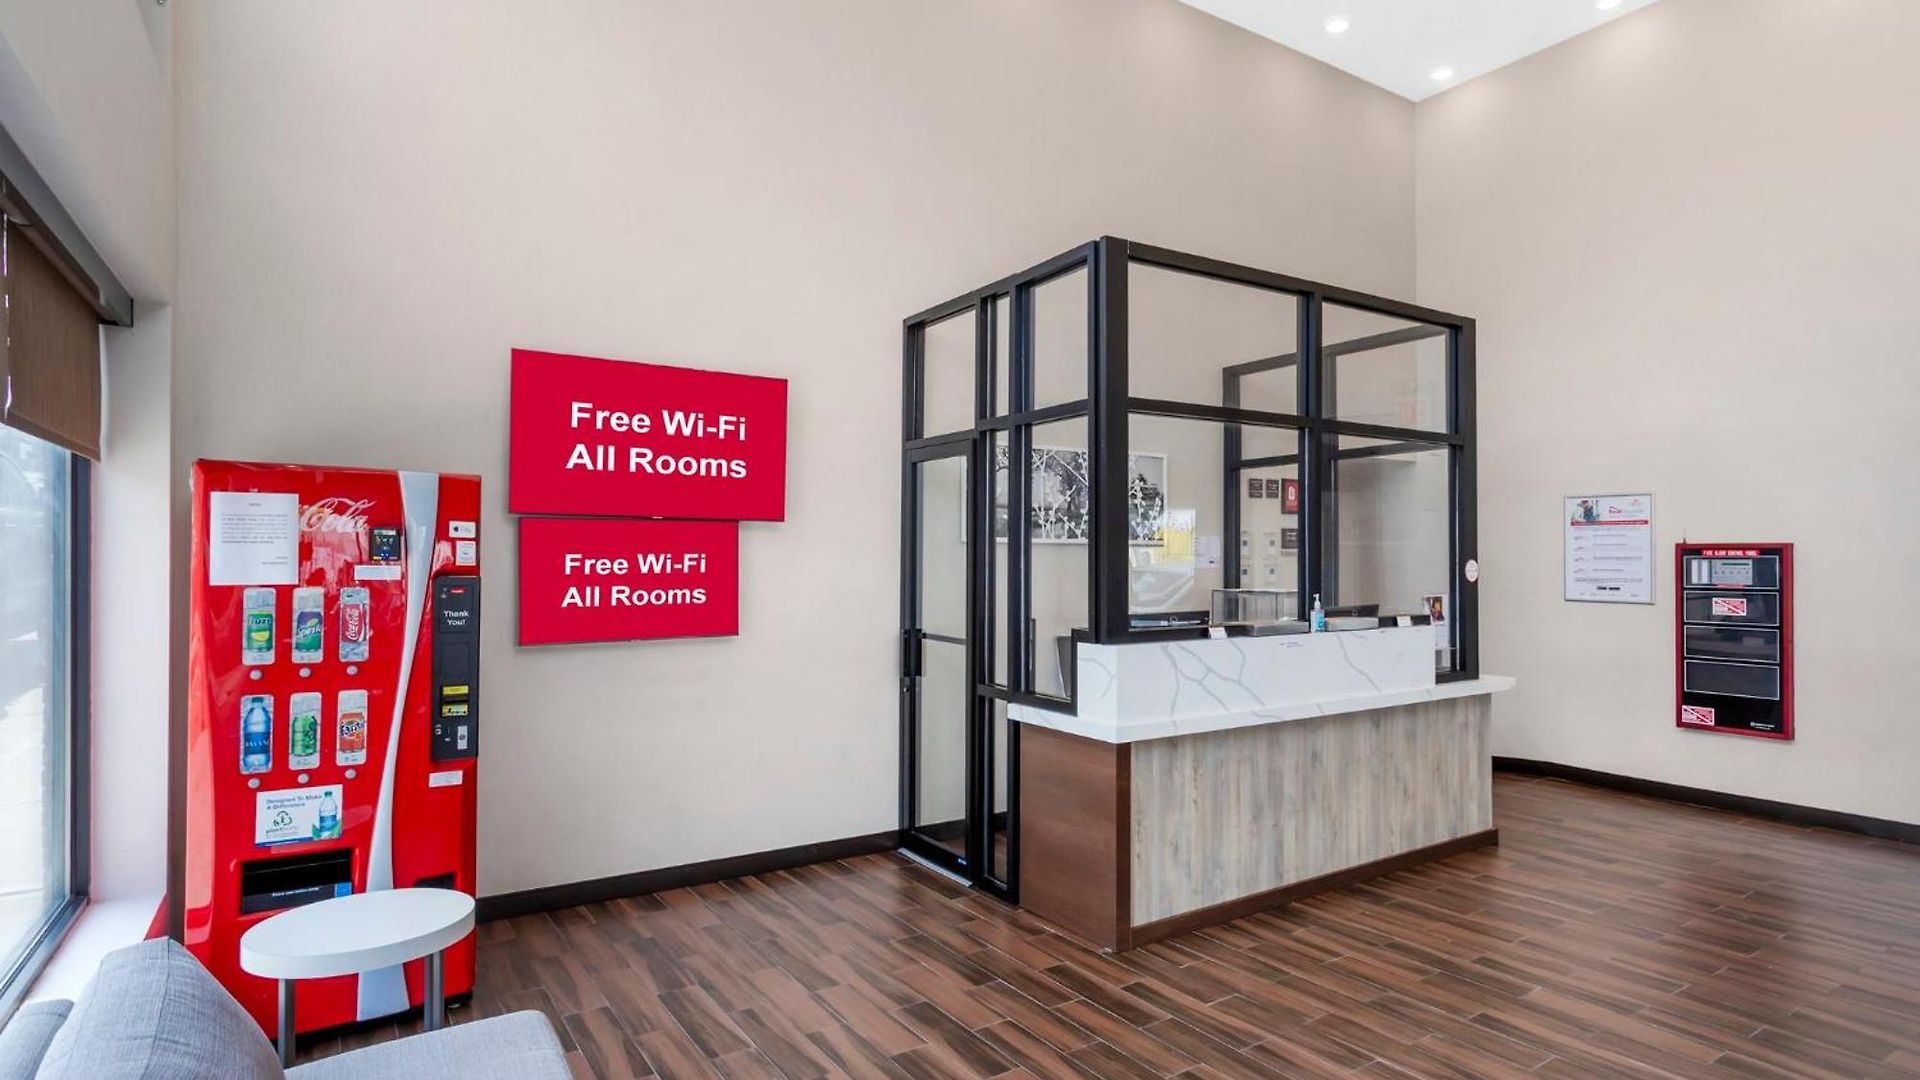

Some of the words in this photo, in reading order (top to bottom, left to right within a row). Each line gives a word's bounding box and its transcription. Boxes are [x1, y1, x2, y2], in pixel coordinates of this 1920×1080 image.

[571, 401, 651, 433] Free
[661, 409, 746, 441] Wi-Fi
[565, 443, 615, 471] All
[629, 447, 747, 478] Rooms
[564, 553, 629, 575] Free
[637, 553, 706, 574] Wi-Fi
[561, 585, 600, 608] All
[611, 585, 707, 607] Rooms
